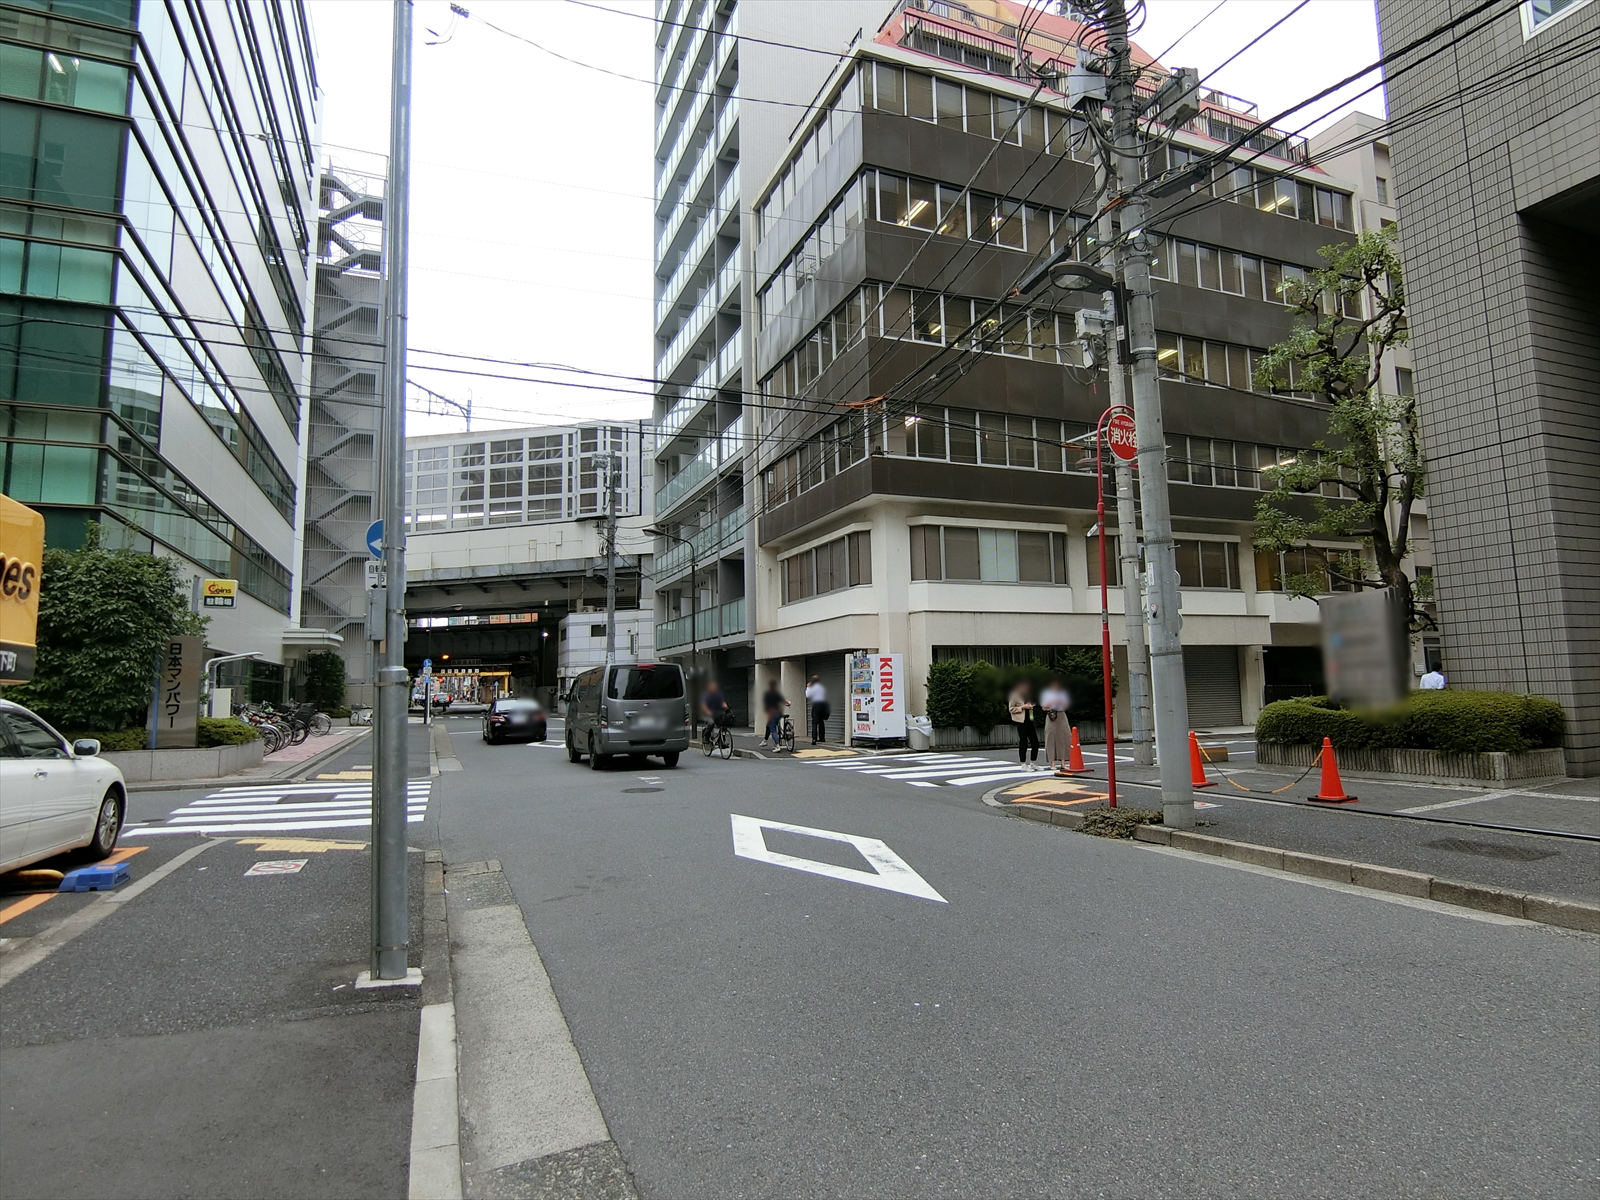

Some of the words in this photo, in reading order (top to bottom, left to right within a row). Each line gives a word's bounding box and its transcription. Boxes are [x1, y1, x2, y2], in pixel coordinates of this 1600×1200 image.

[1110, 426, 1137, 448] 消火栓
[208, 583, 232, 595] Coins
[165, 642, 182, 728] 日本マンパワー
[880, 657, 894, 713] KIRIN
[857, 723, 871, 732] KIRIN
